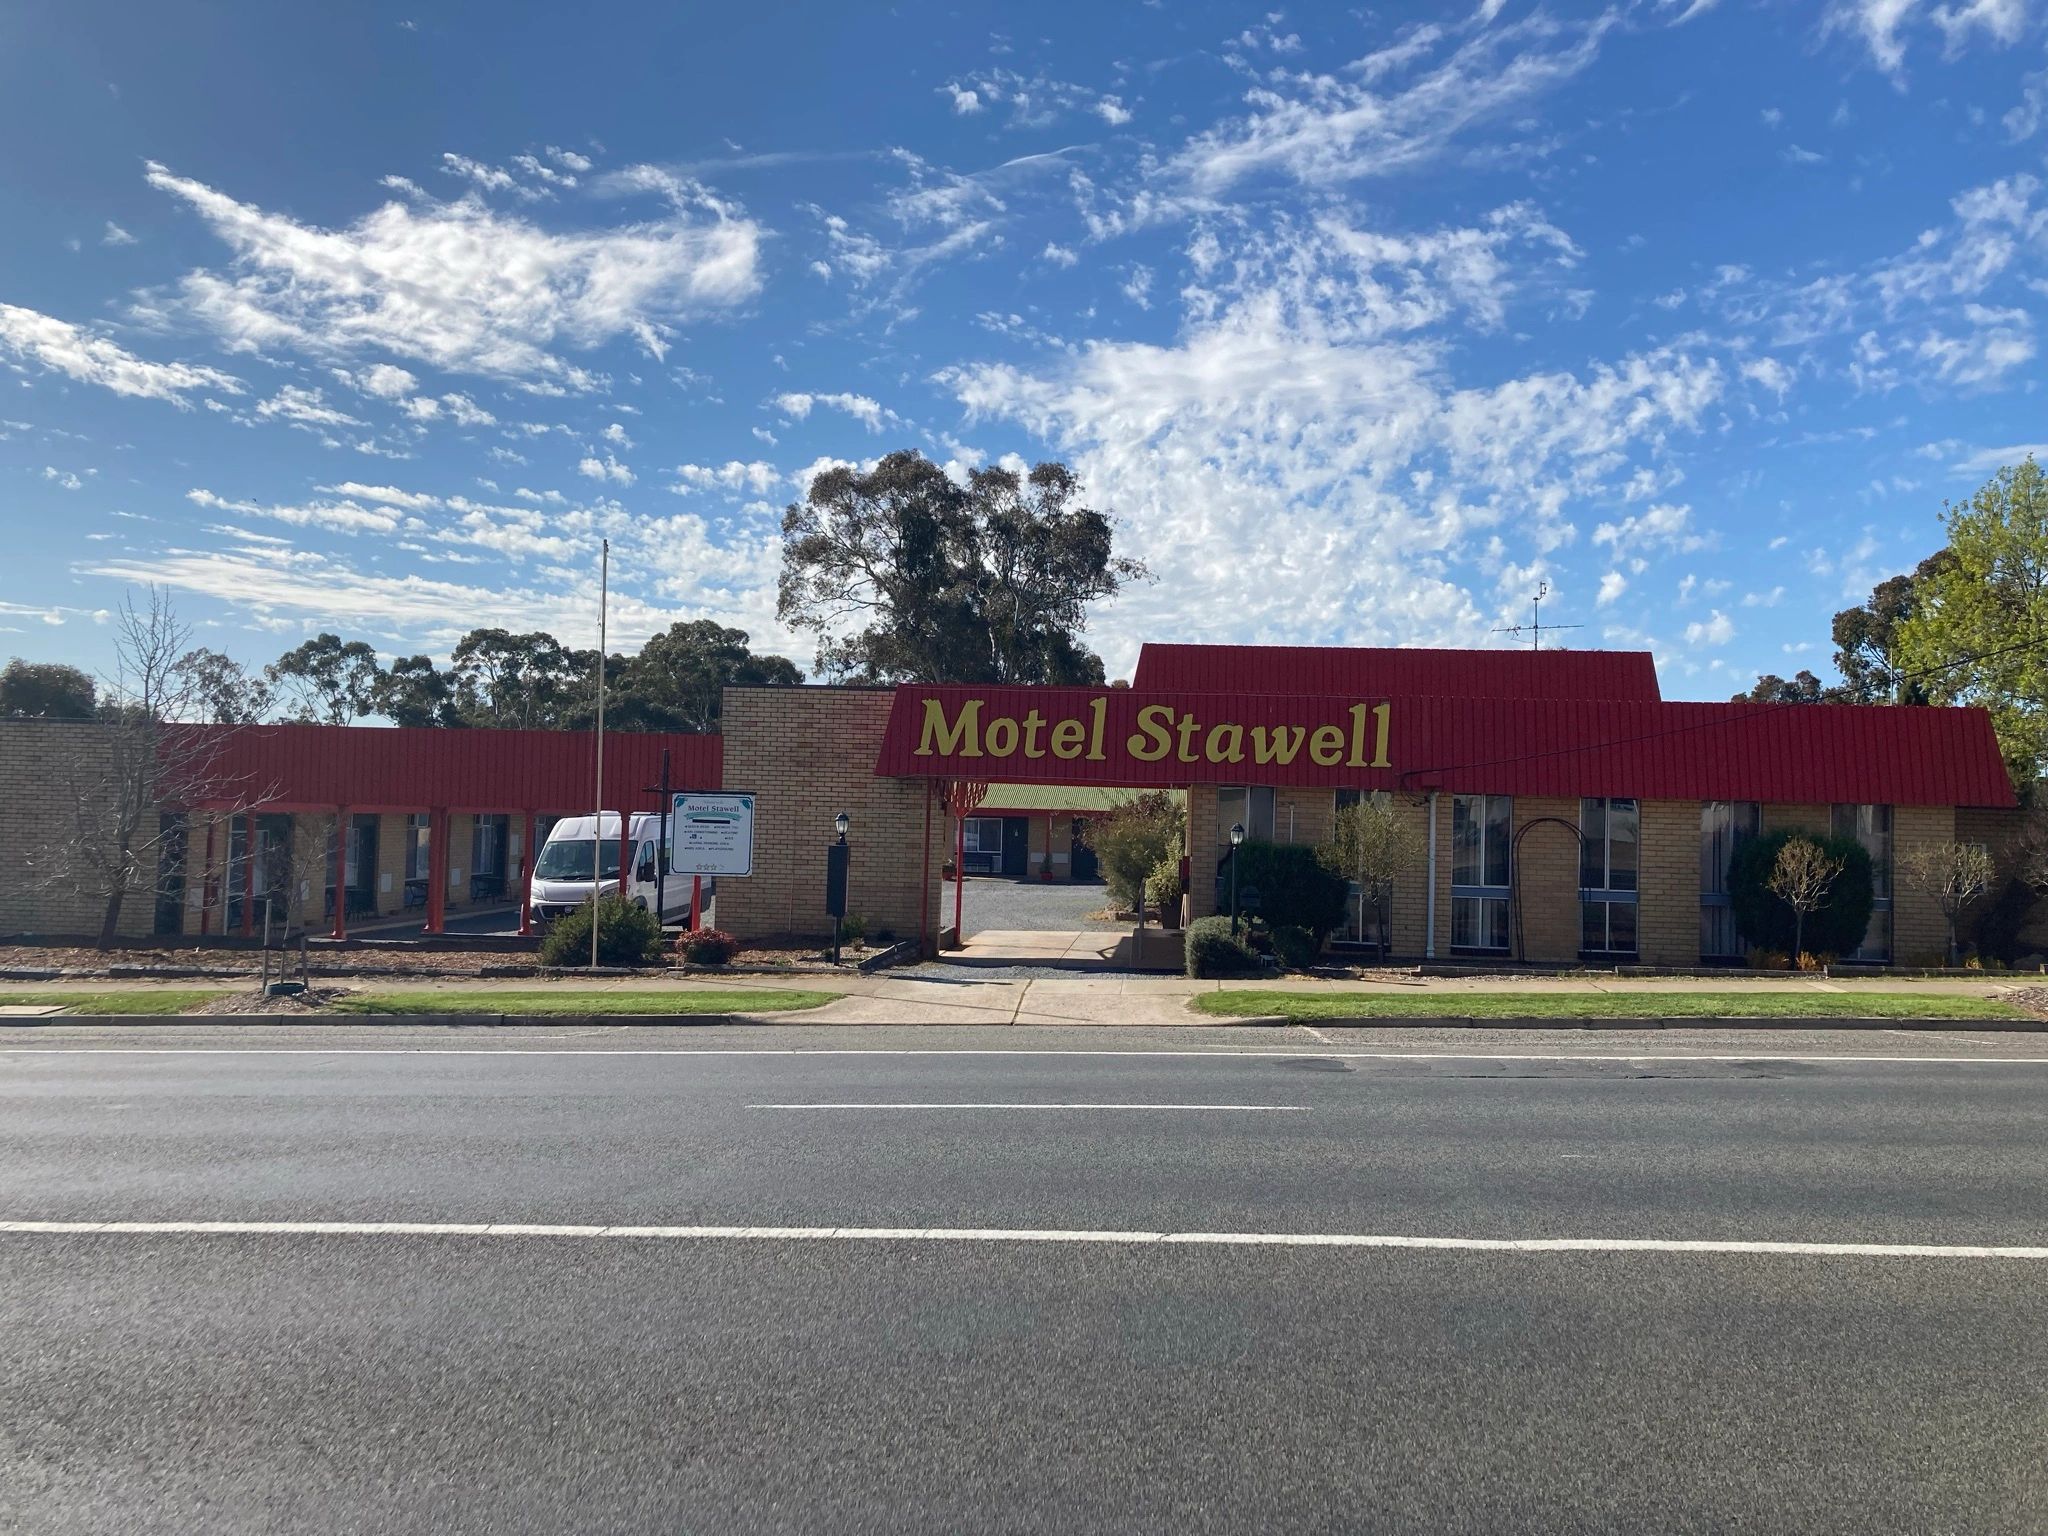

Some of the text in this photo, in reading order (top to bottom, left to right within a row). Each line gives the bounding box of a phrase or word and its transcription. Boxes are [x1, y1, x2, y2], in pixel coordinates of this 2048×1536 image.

[914, 698, 1391, 768] Motel Stawell
[711, 805, 739, 813] Stawell
